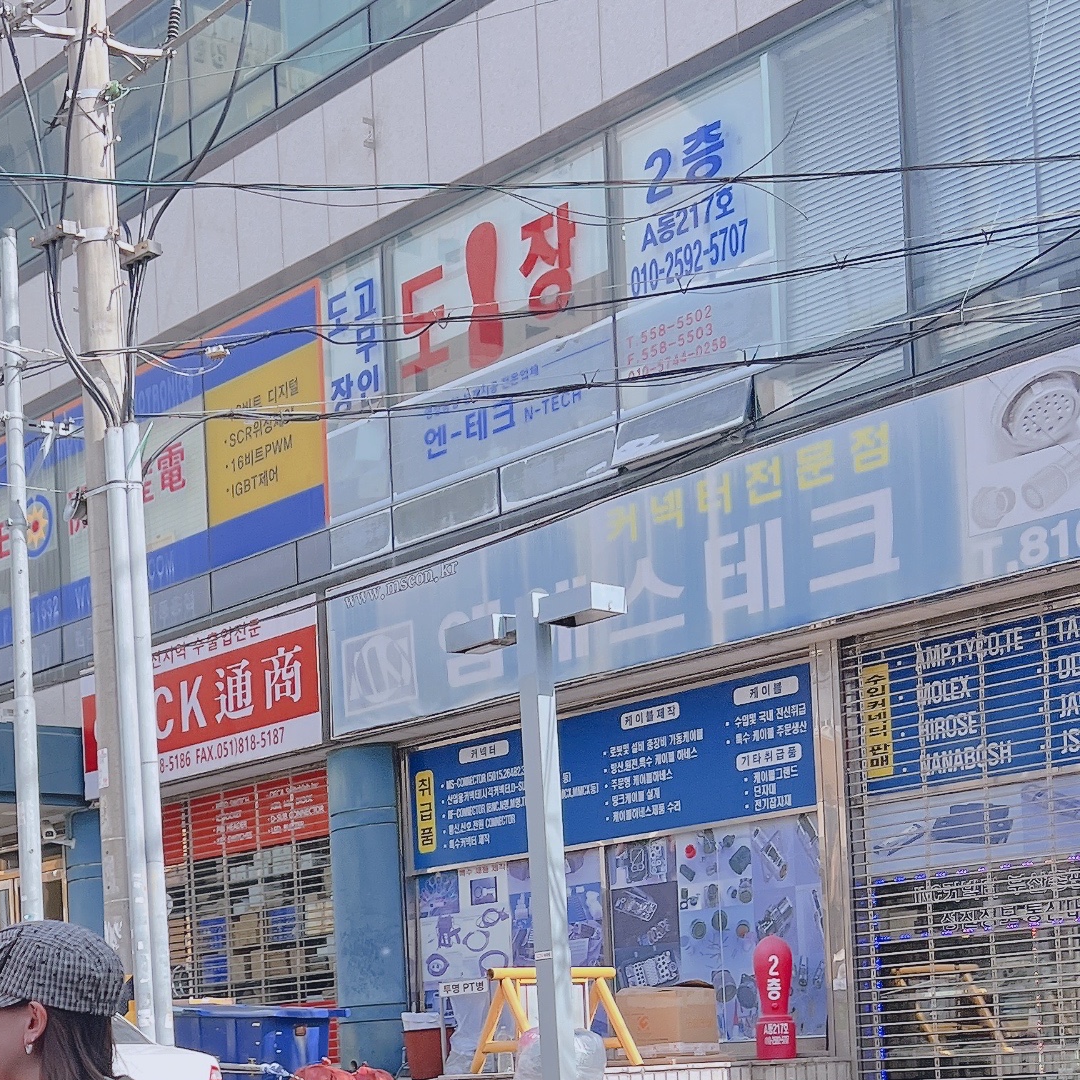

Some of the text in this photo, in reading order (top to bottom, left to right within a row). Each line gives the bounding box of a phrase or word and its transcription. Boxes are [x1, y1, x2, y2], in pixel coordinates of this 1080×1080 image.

[644, 120, 725, 204] 2층
[642, 185, 735, 252] A동217호
[631, 218, 749, 297] 010-2592-5707
[625, 304, 713, 349] T.558-5502
[626, 322, 714, 366] F.558-5503
[267, 377, 299, 403] 디지털
[424, 397, 516, 459] 엔-테크
[523, 391, 582, 423] N-TECH
[231, 434, 293, 472] 16비트PWM
[231, 465, 279, 498] IGBT제어
[607, 422, 891, 542] 커넥터전문점
[749, 681, 783, 699] 케이블
[918, 674, 971, 706] MOLEX
[624, 705, 676, 727] 케이블제작
[920, 710, 979, 742] HIROSE
[195, 727, 285, 765] FAX.051)818-5187
[470, 743, 497, 759] 커넥터
[741, 747, 797, 766] 기타취급품
[418, 776, 434, 846] 취급품
[442, 981, 484, 994] 투명 PT병
[767, 954, 782, 1001] 2층
